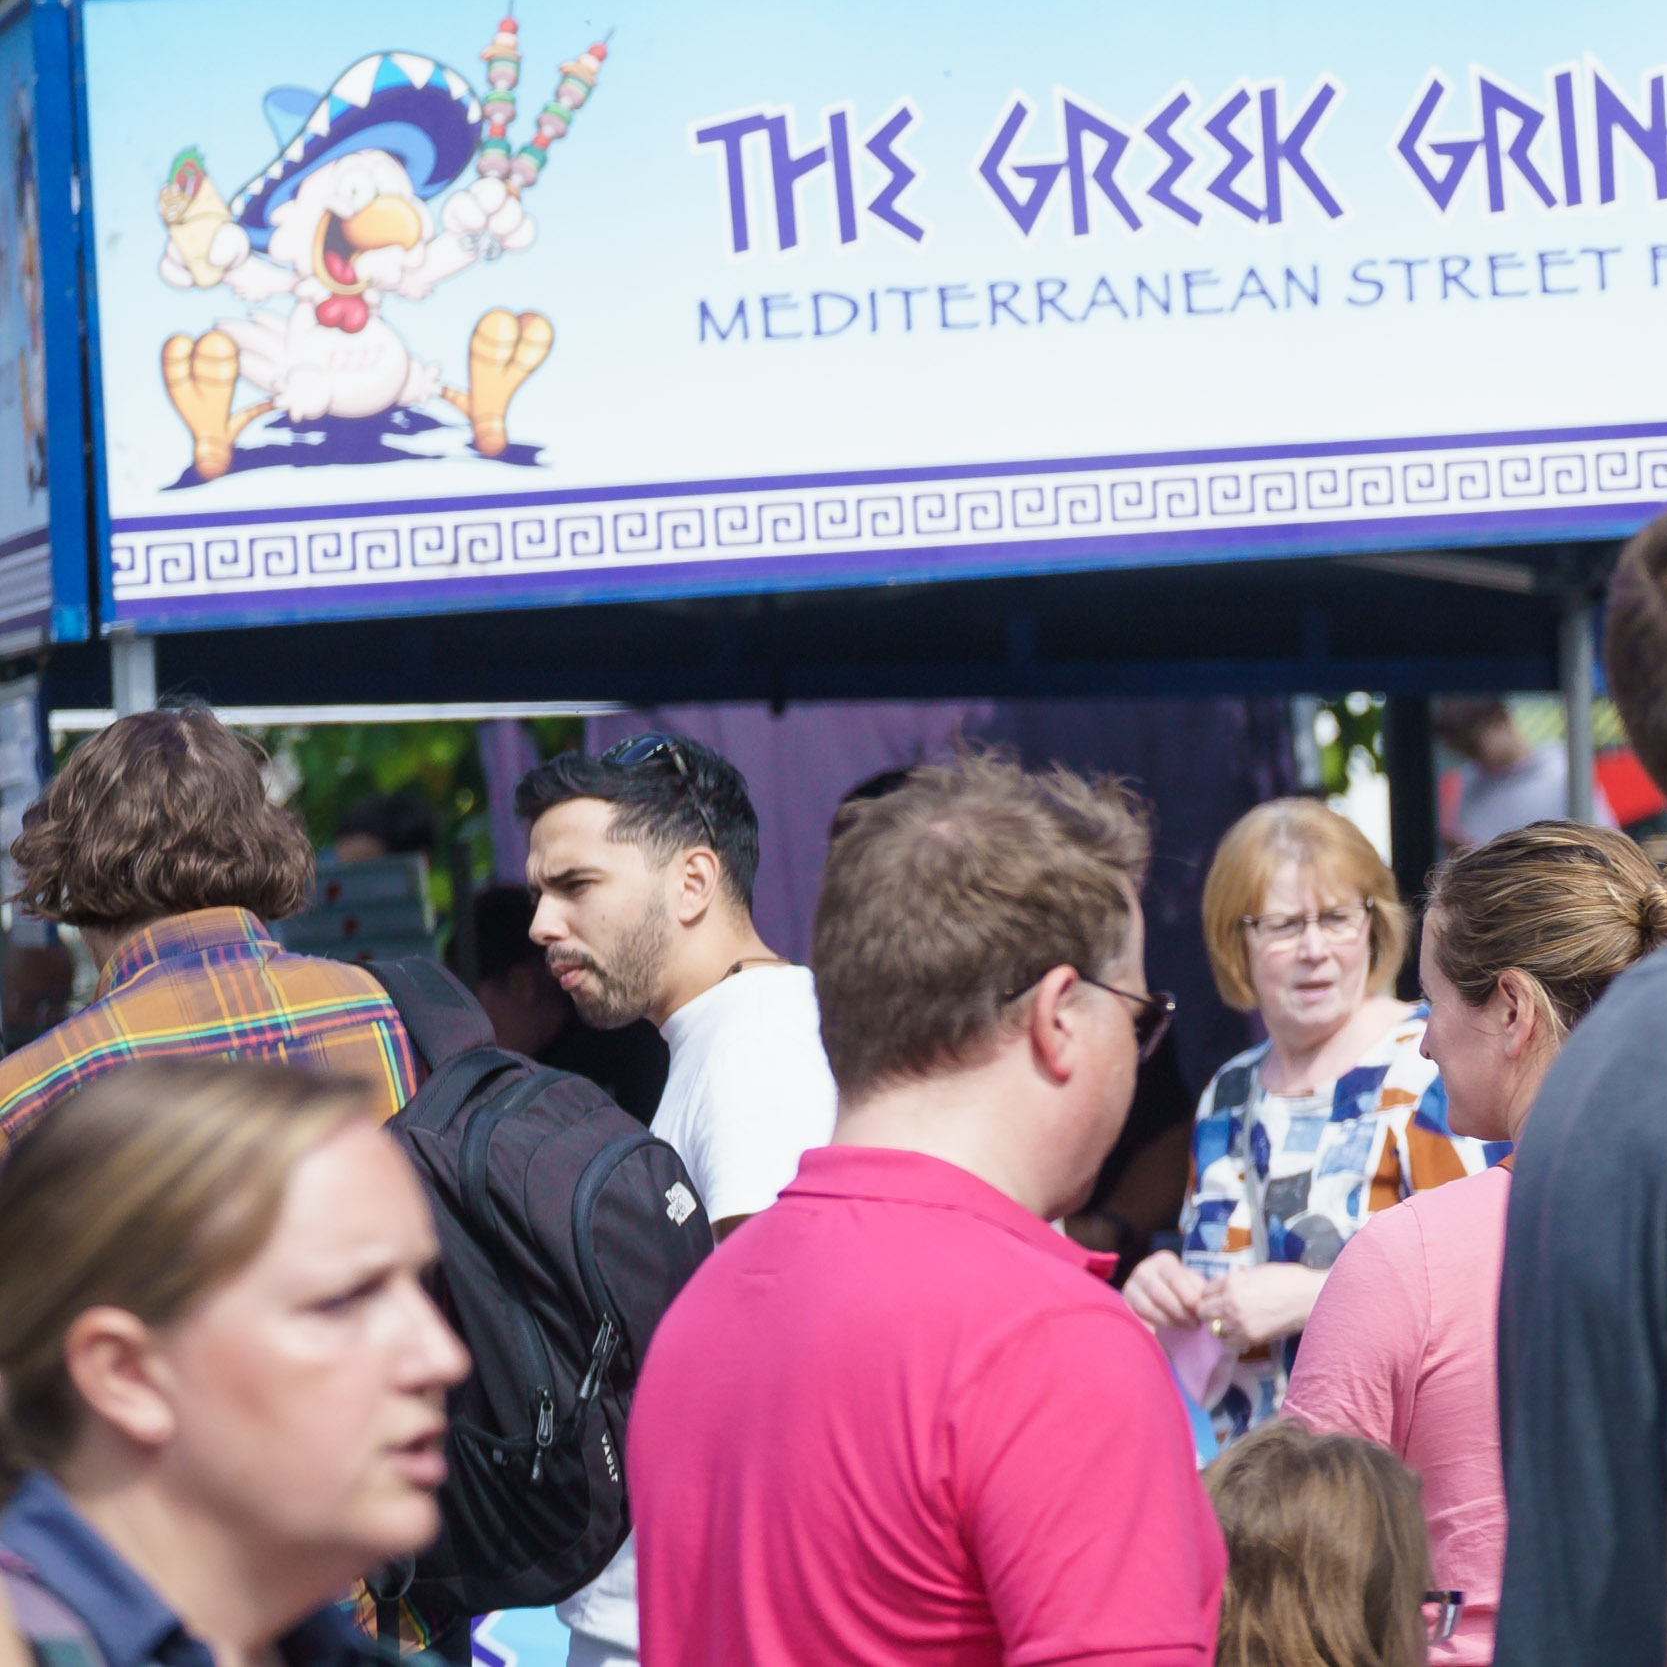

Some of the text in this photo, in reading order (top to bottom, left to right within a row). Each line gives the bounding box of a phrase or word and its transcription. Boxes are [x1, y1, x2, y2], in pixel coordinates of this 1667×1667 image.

[696, 105, 925, 253] THE
[978, 82, 1345, 236] GREEK
[698, 265, 1320, 343] MEDITERRANEAN
[1346, 246, 1623, 307] STREET
[601, 1432, 619, 1483] VAULT
